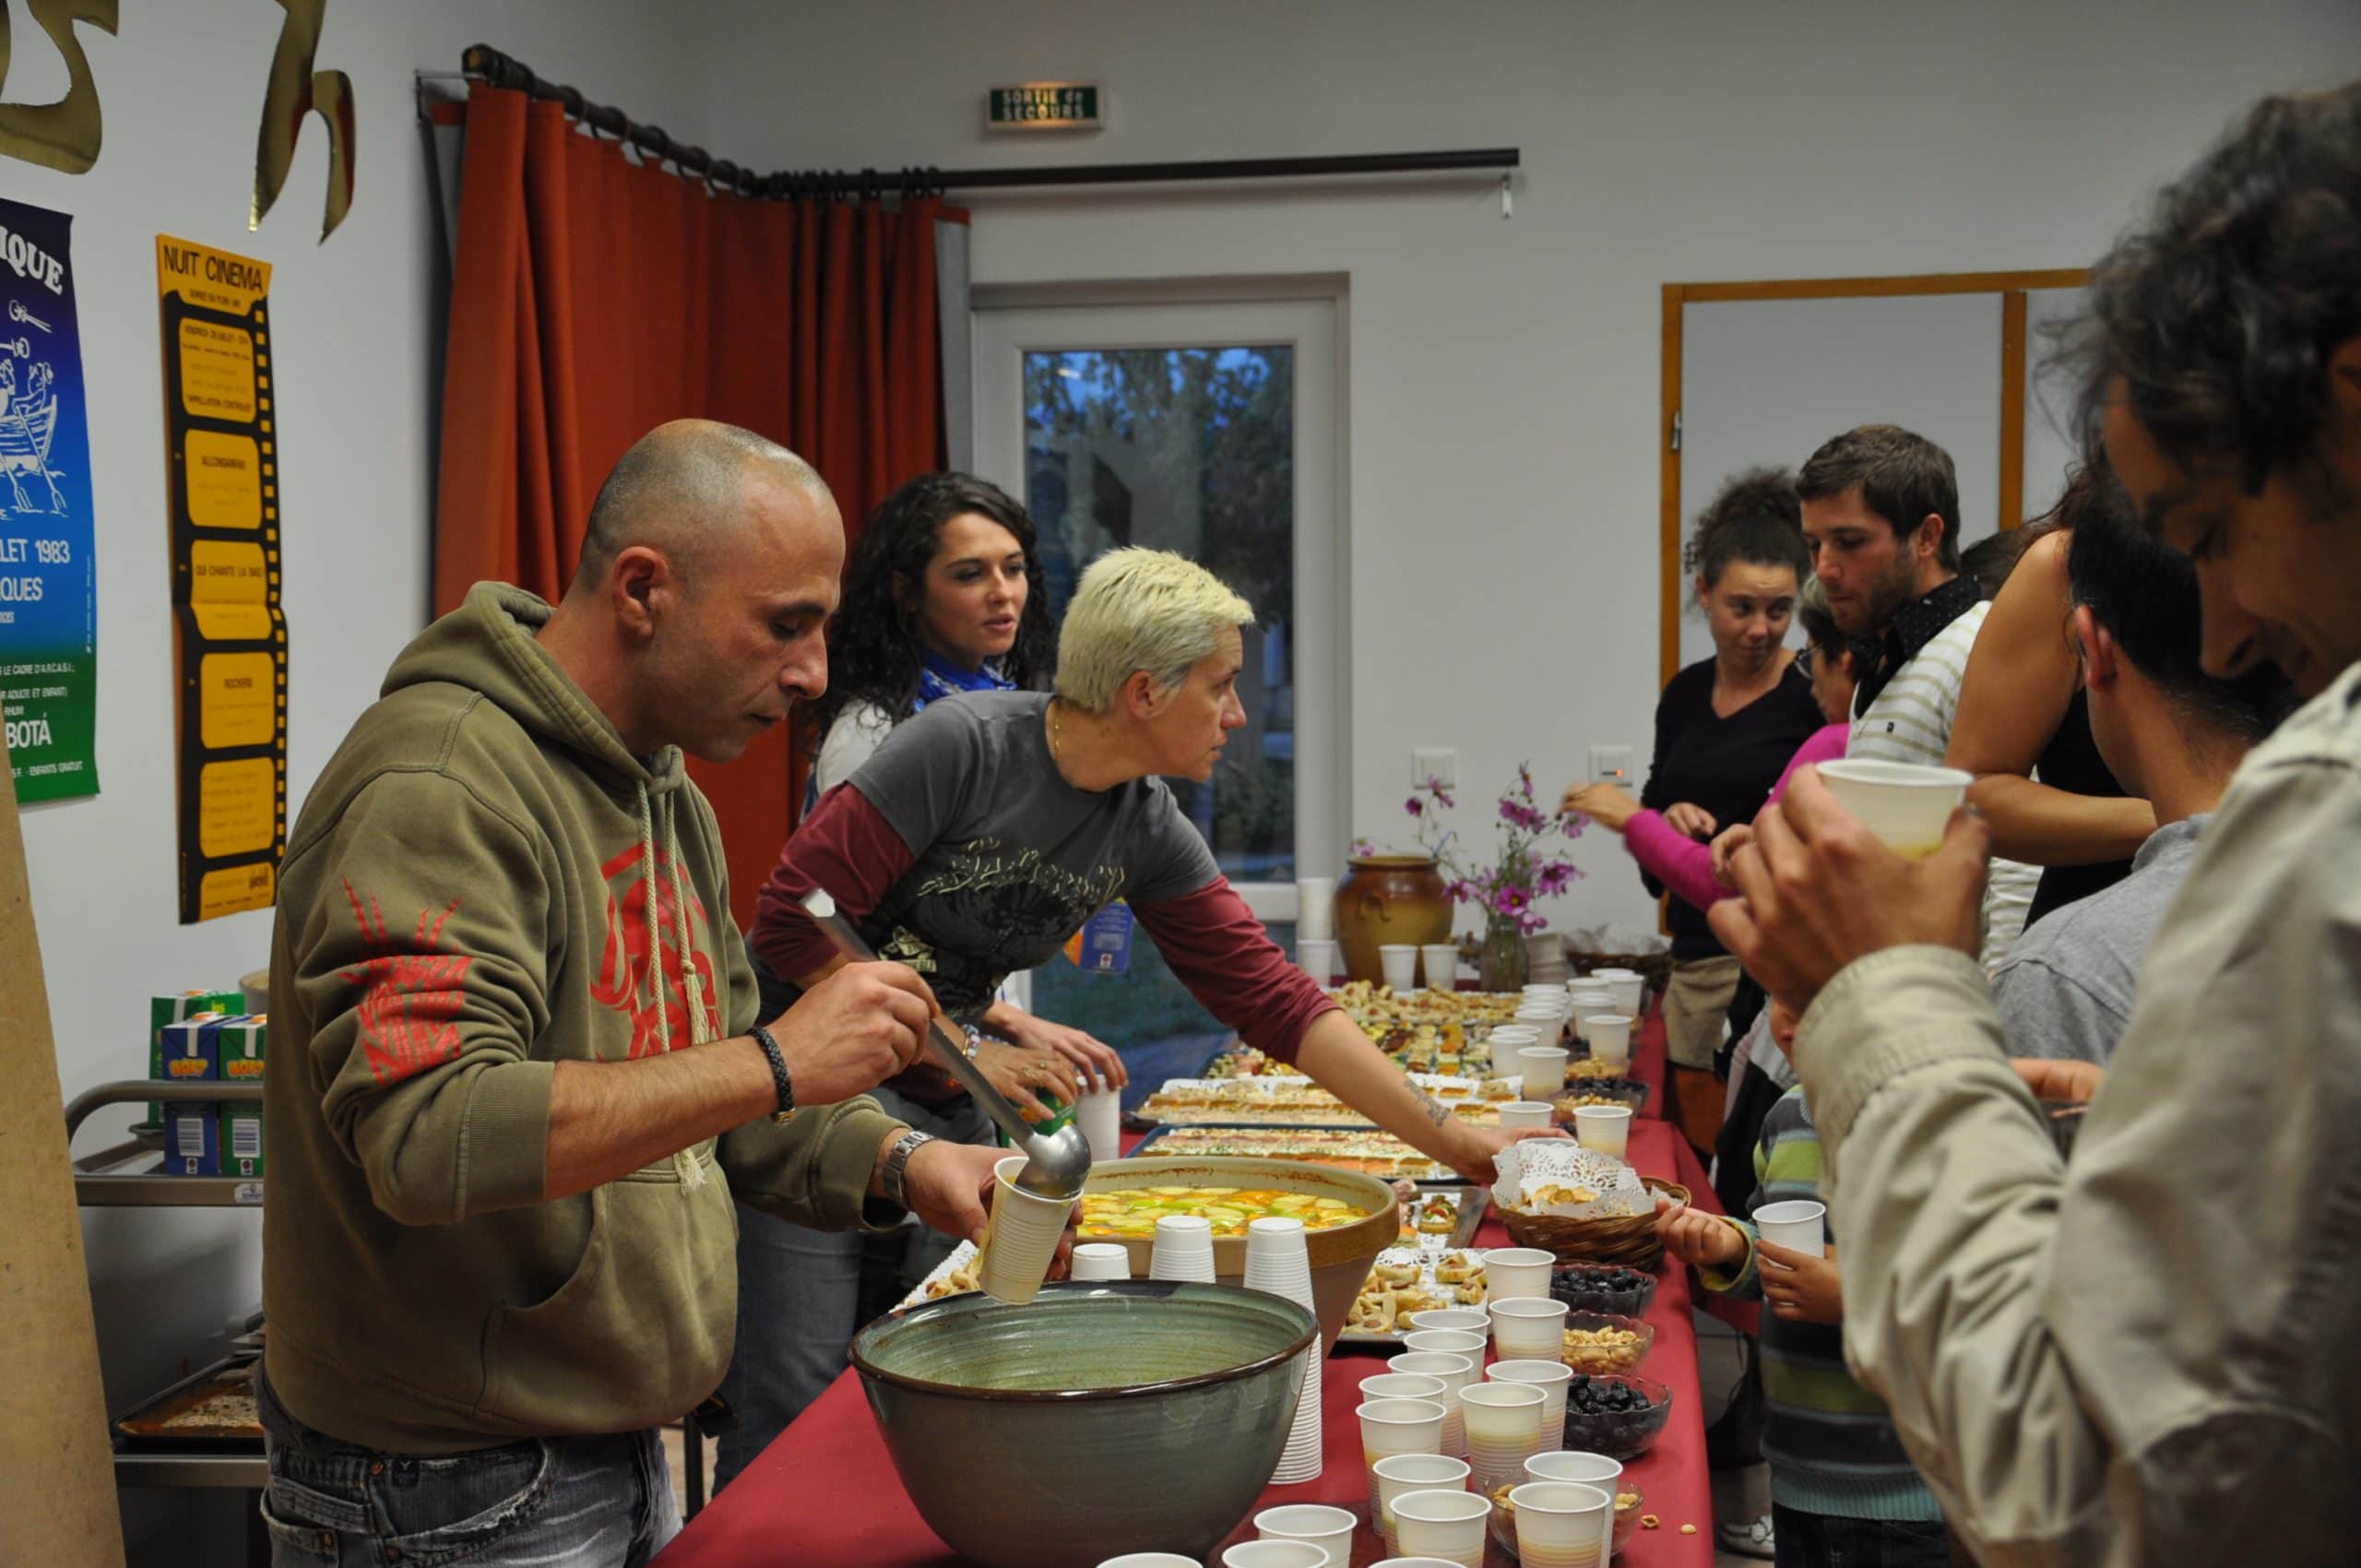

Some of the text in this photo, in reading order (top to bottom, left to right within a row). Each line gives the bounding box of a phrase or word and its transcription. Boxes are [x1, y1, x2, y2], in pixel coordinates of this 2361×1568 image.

[1003, 105, 1085, 120] SECOURS
[164, 245, 263, 292] NUIT CINEMA
[35, 540, 70, 564] 1983
[0, 576, 42, 601] QUES
